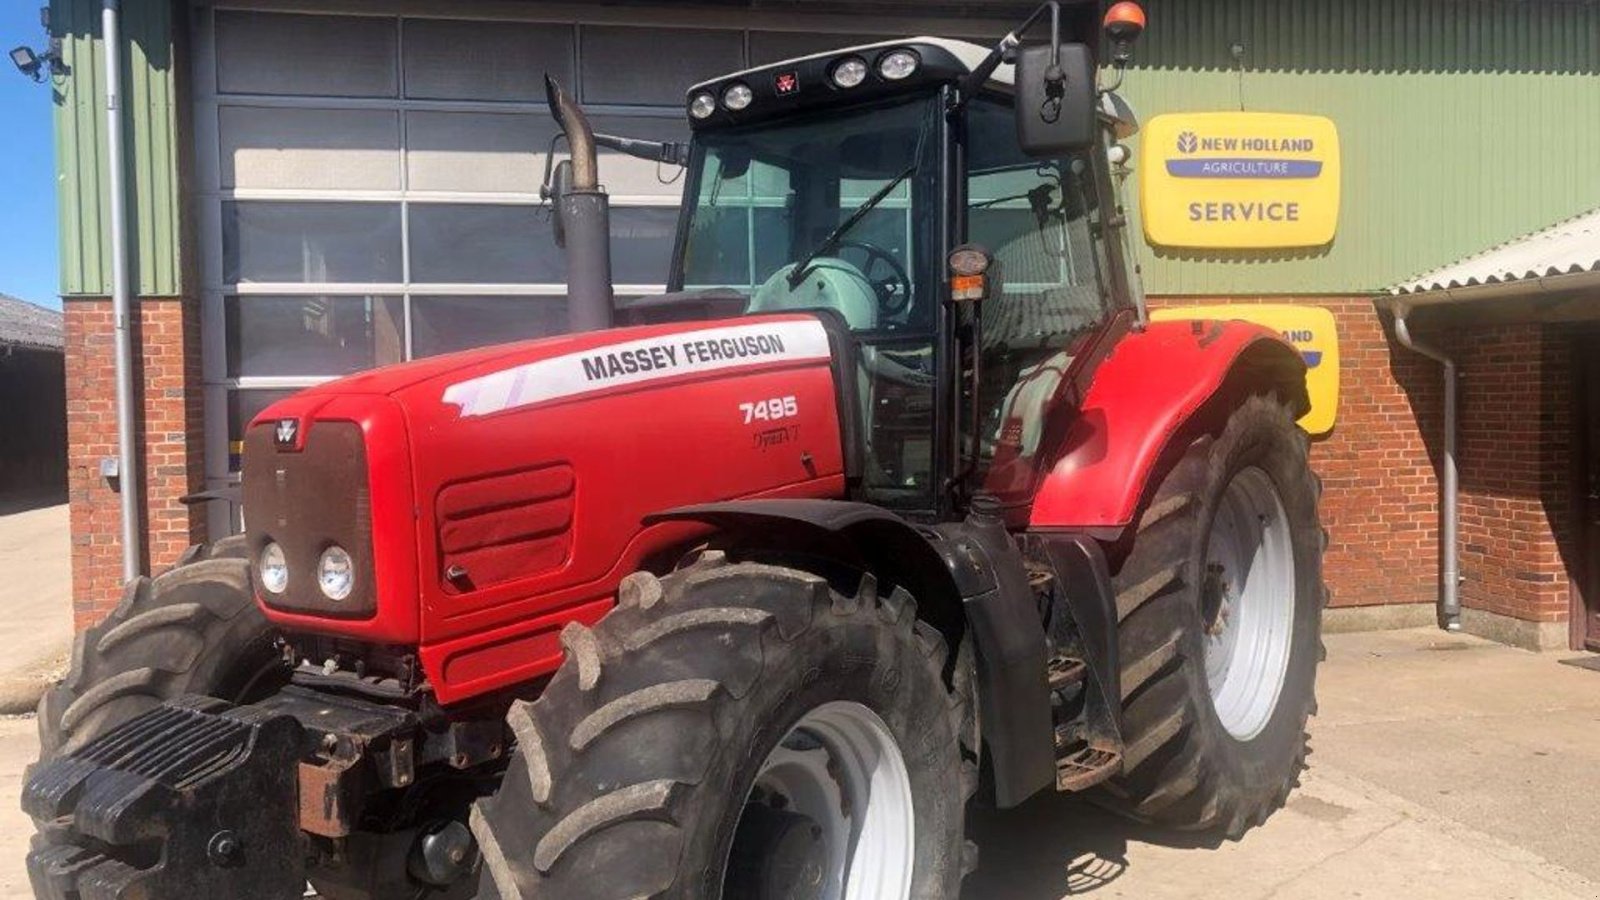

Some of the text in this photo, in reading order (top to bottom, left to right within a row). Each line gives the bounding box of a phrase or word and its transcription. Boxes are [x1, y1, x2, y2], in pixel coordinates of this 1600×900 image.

[1201, 138, 1314, 152] NEW HOLLAND
[1201, 161, 1289, 174] AGRICULTURE
[1188, 202, 1299, 222] SERVICE
[581, 334, 786, 380] MASSEY FERGUSON
[739, 396, 798, 425] 7495
